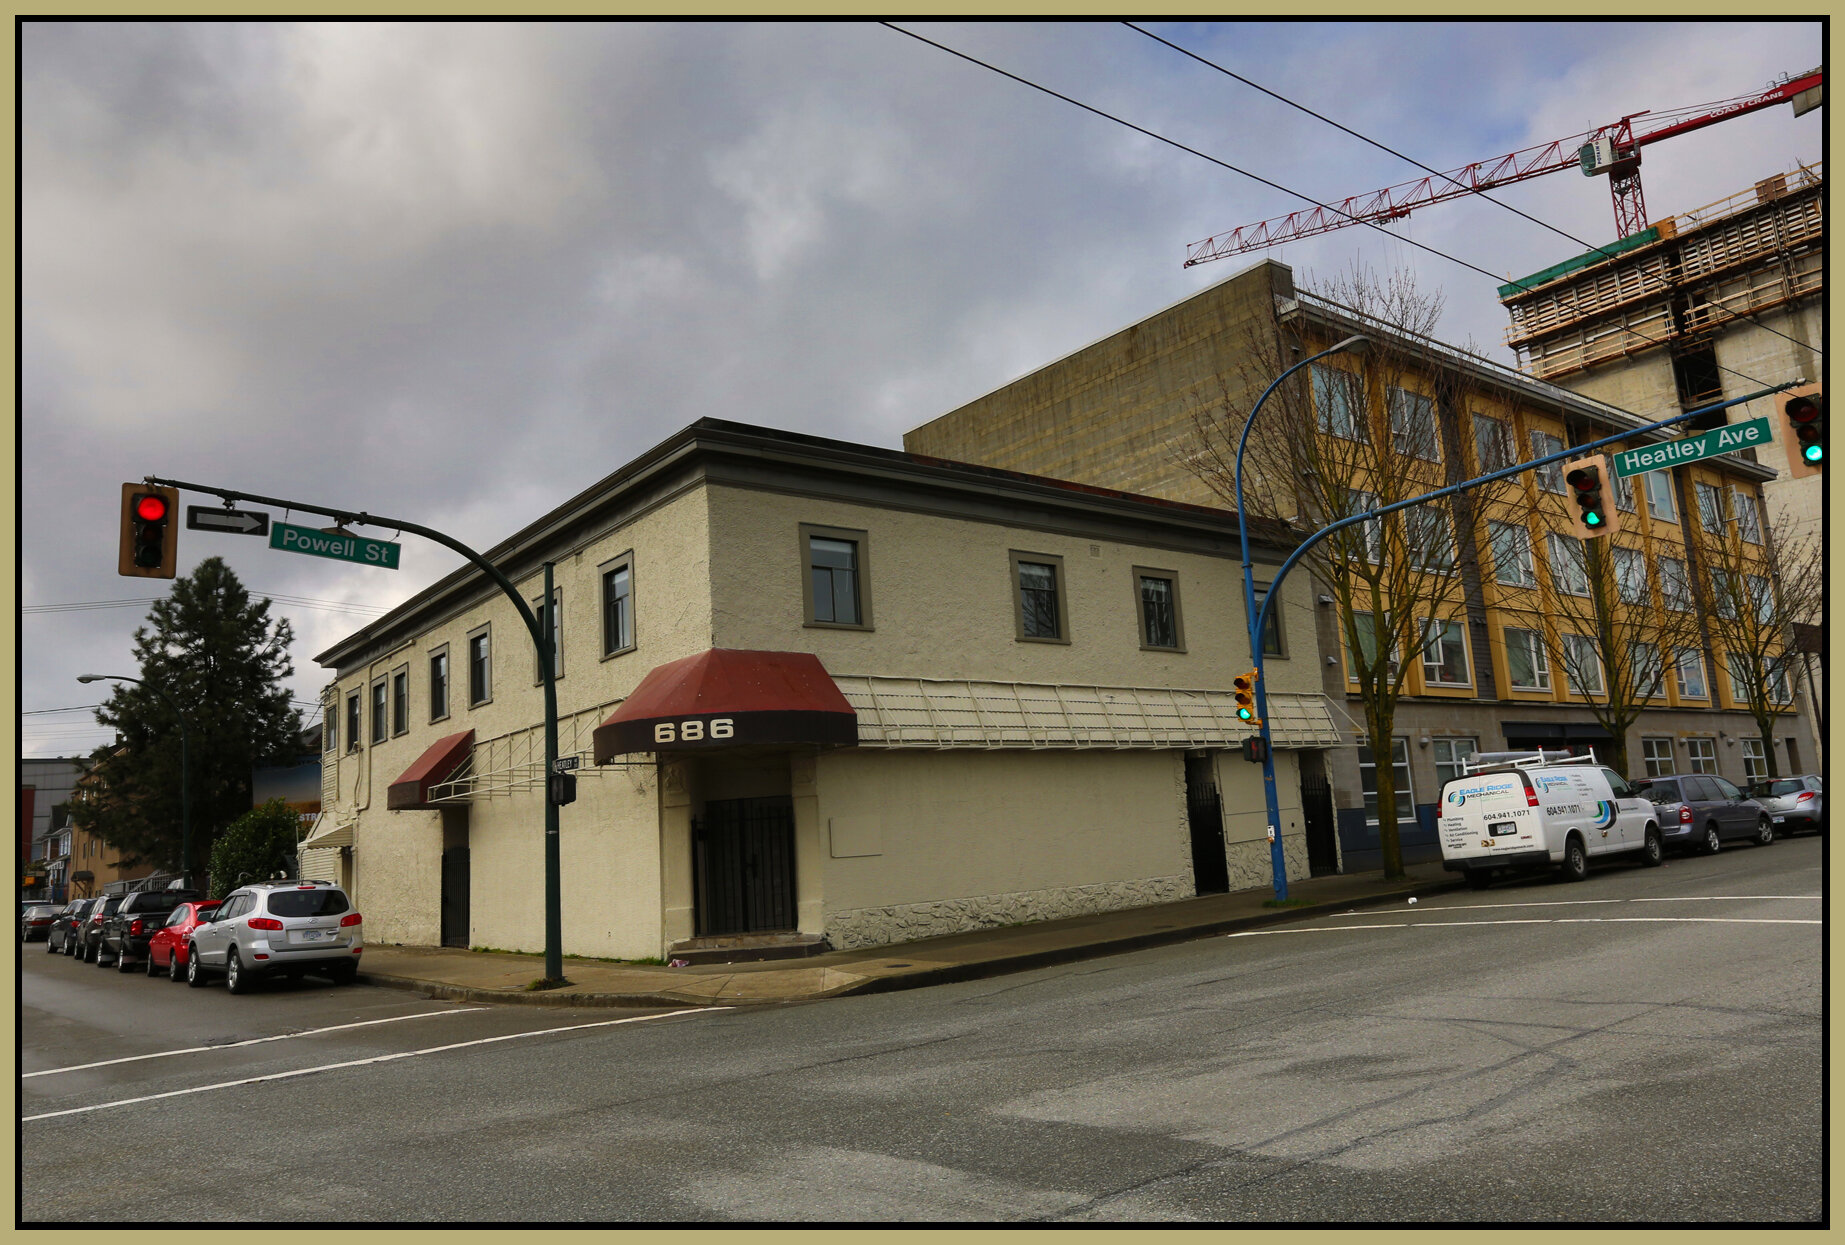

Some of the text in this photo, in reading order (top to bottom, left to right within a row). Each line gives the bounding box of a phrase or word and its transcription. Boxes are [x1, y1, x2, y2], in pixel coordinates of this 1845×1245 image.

[1710, 91, 1784, 118] COAST CRANE
[1624, 424, 1760, 470] Heatley Ave
[283, 529, 389, 563] Powell St
[654, 718, 735, 744] 686
[1459, 783, 1514, 796] EAGLE RIDGE
[1466, 789, 1509, 799] MECHANICAL
[1483, 809, 1531, 821] 604.941.1071
[1546, 804, 1581, 816] 604.941.1071
